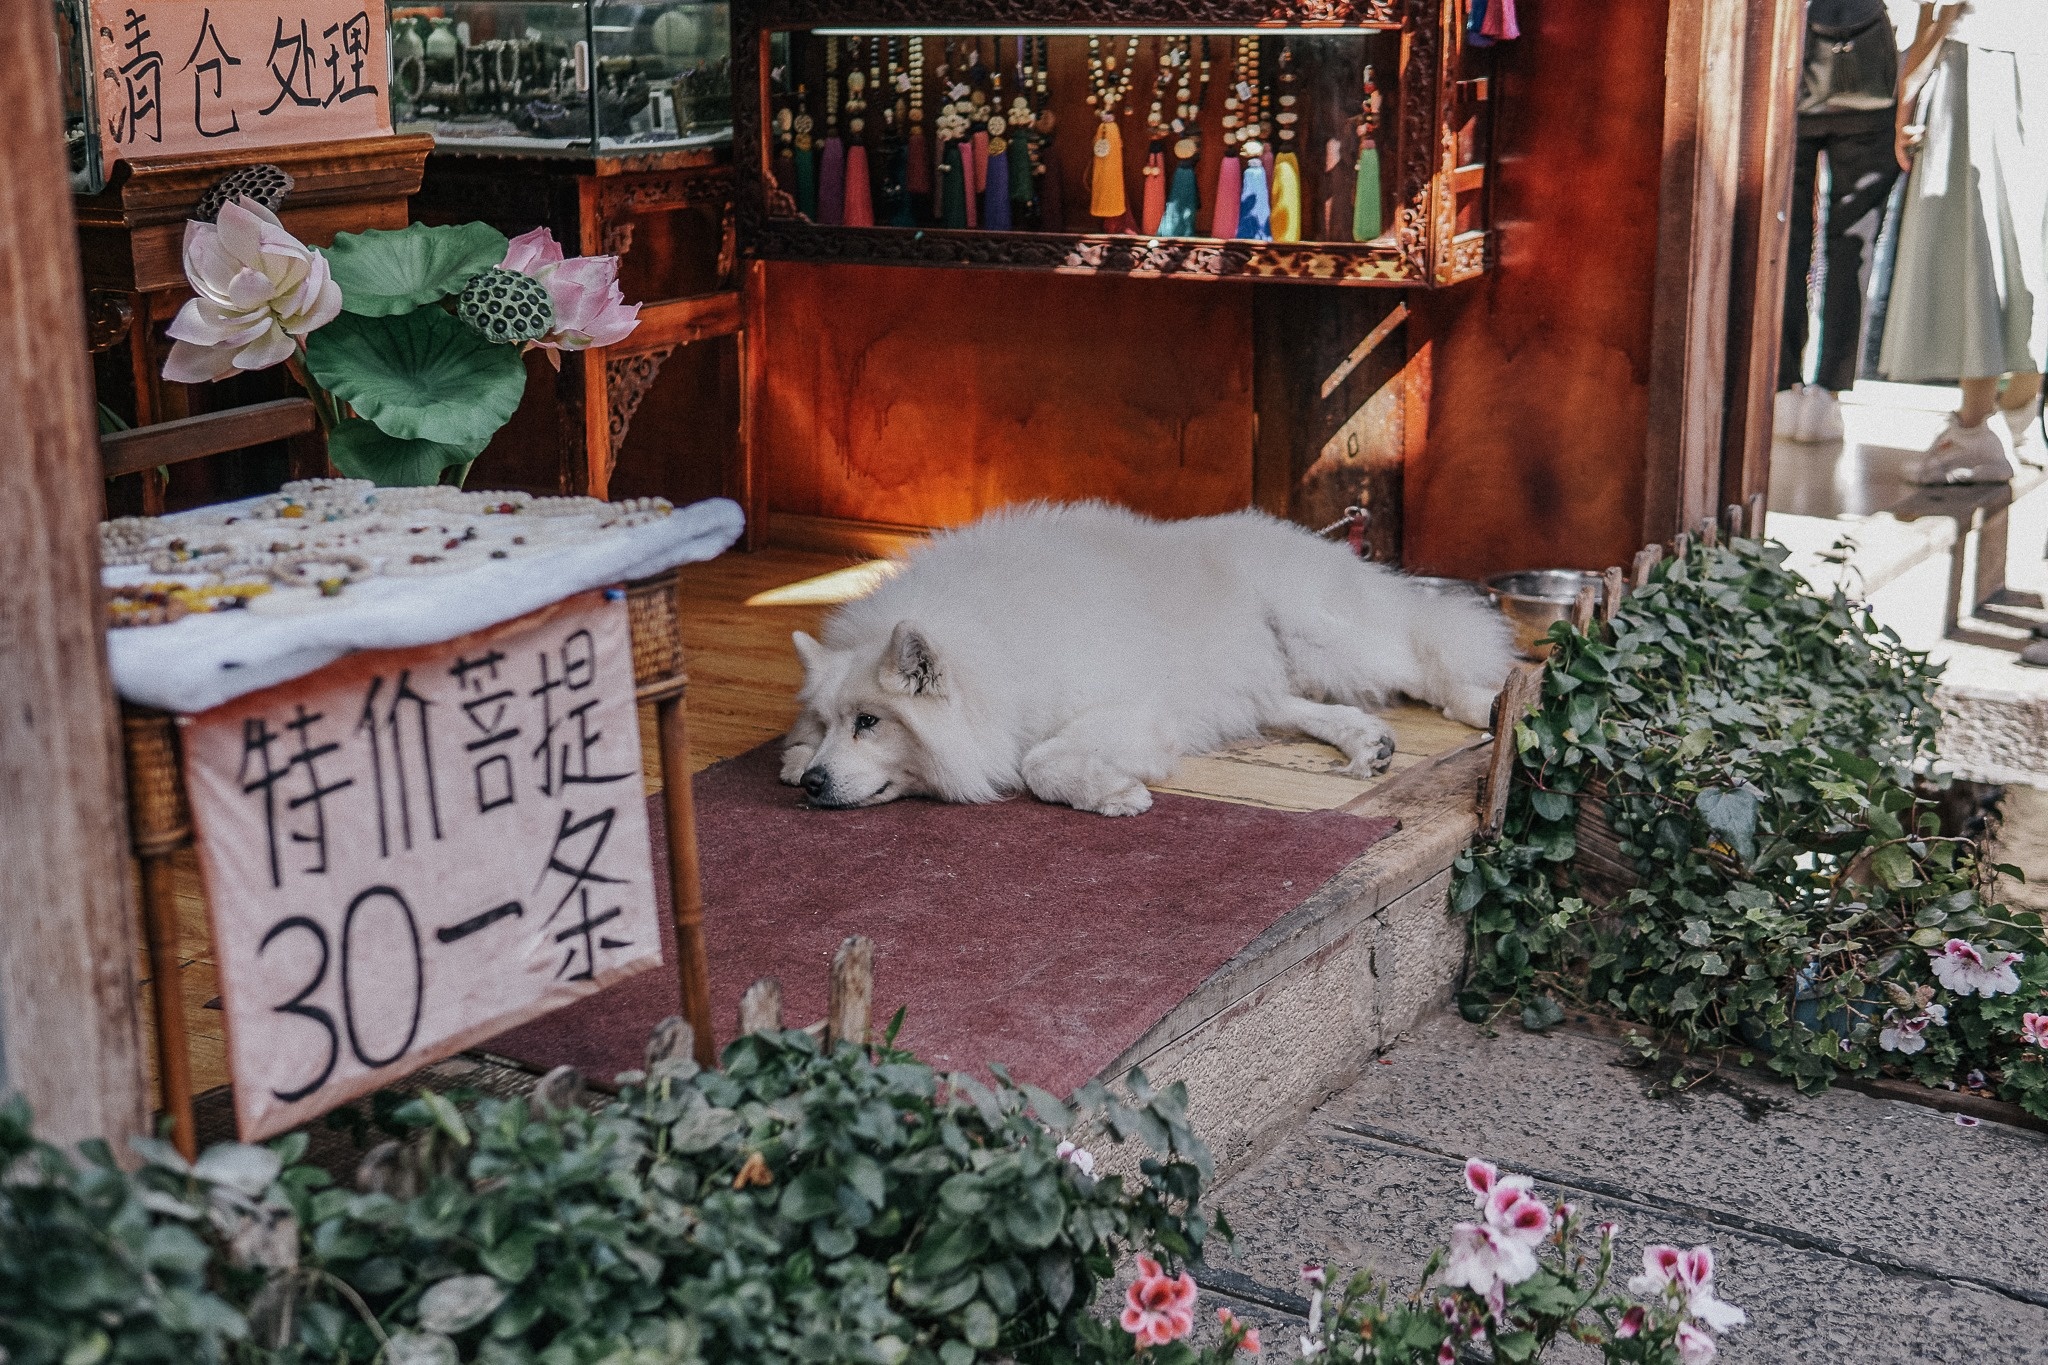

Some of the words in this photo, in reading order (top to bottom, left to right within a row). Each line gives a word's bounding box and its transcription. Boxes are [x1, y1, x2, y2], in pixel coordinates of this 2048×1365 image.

[100, 7, 379, 144] 清仓处理
[237, 628, 636, 887] 特价菩提
[257, 807, 634, 1102] 30一条
